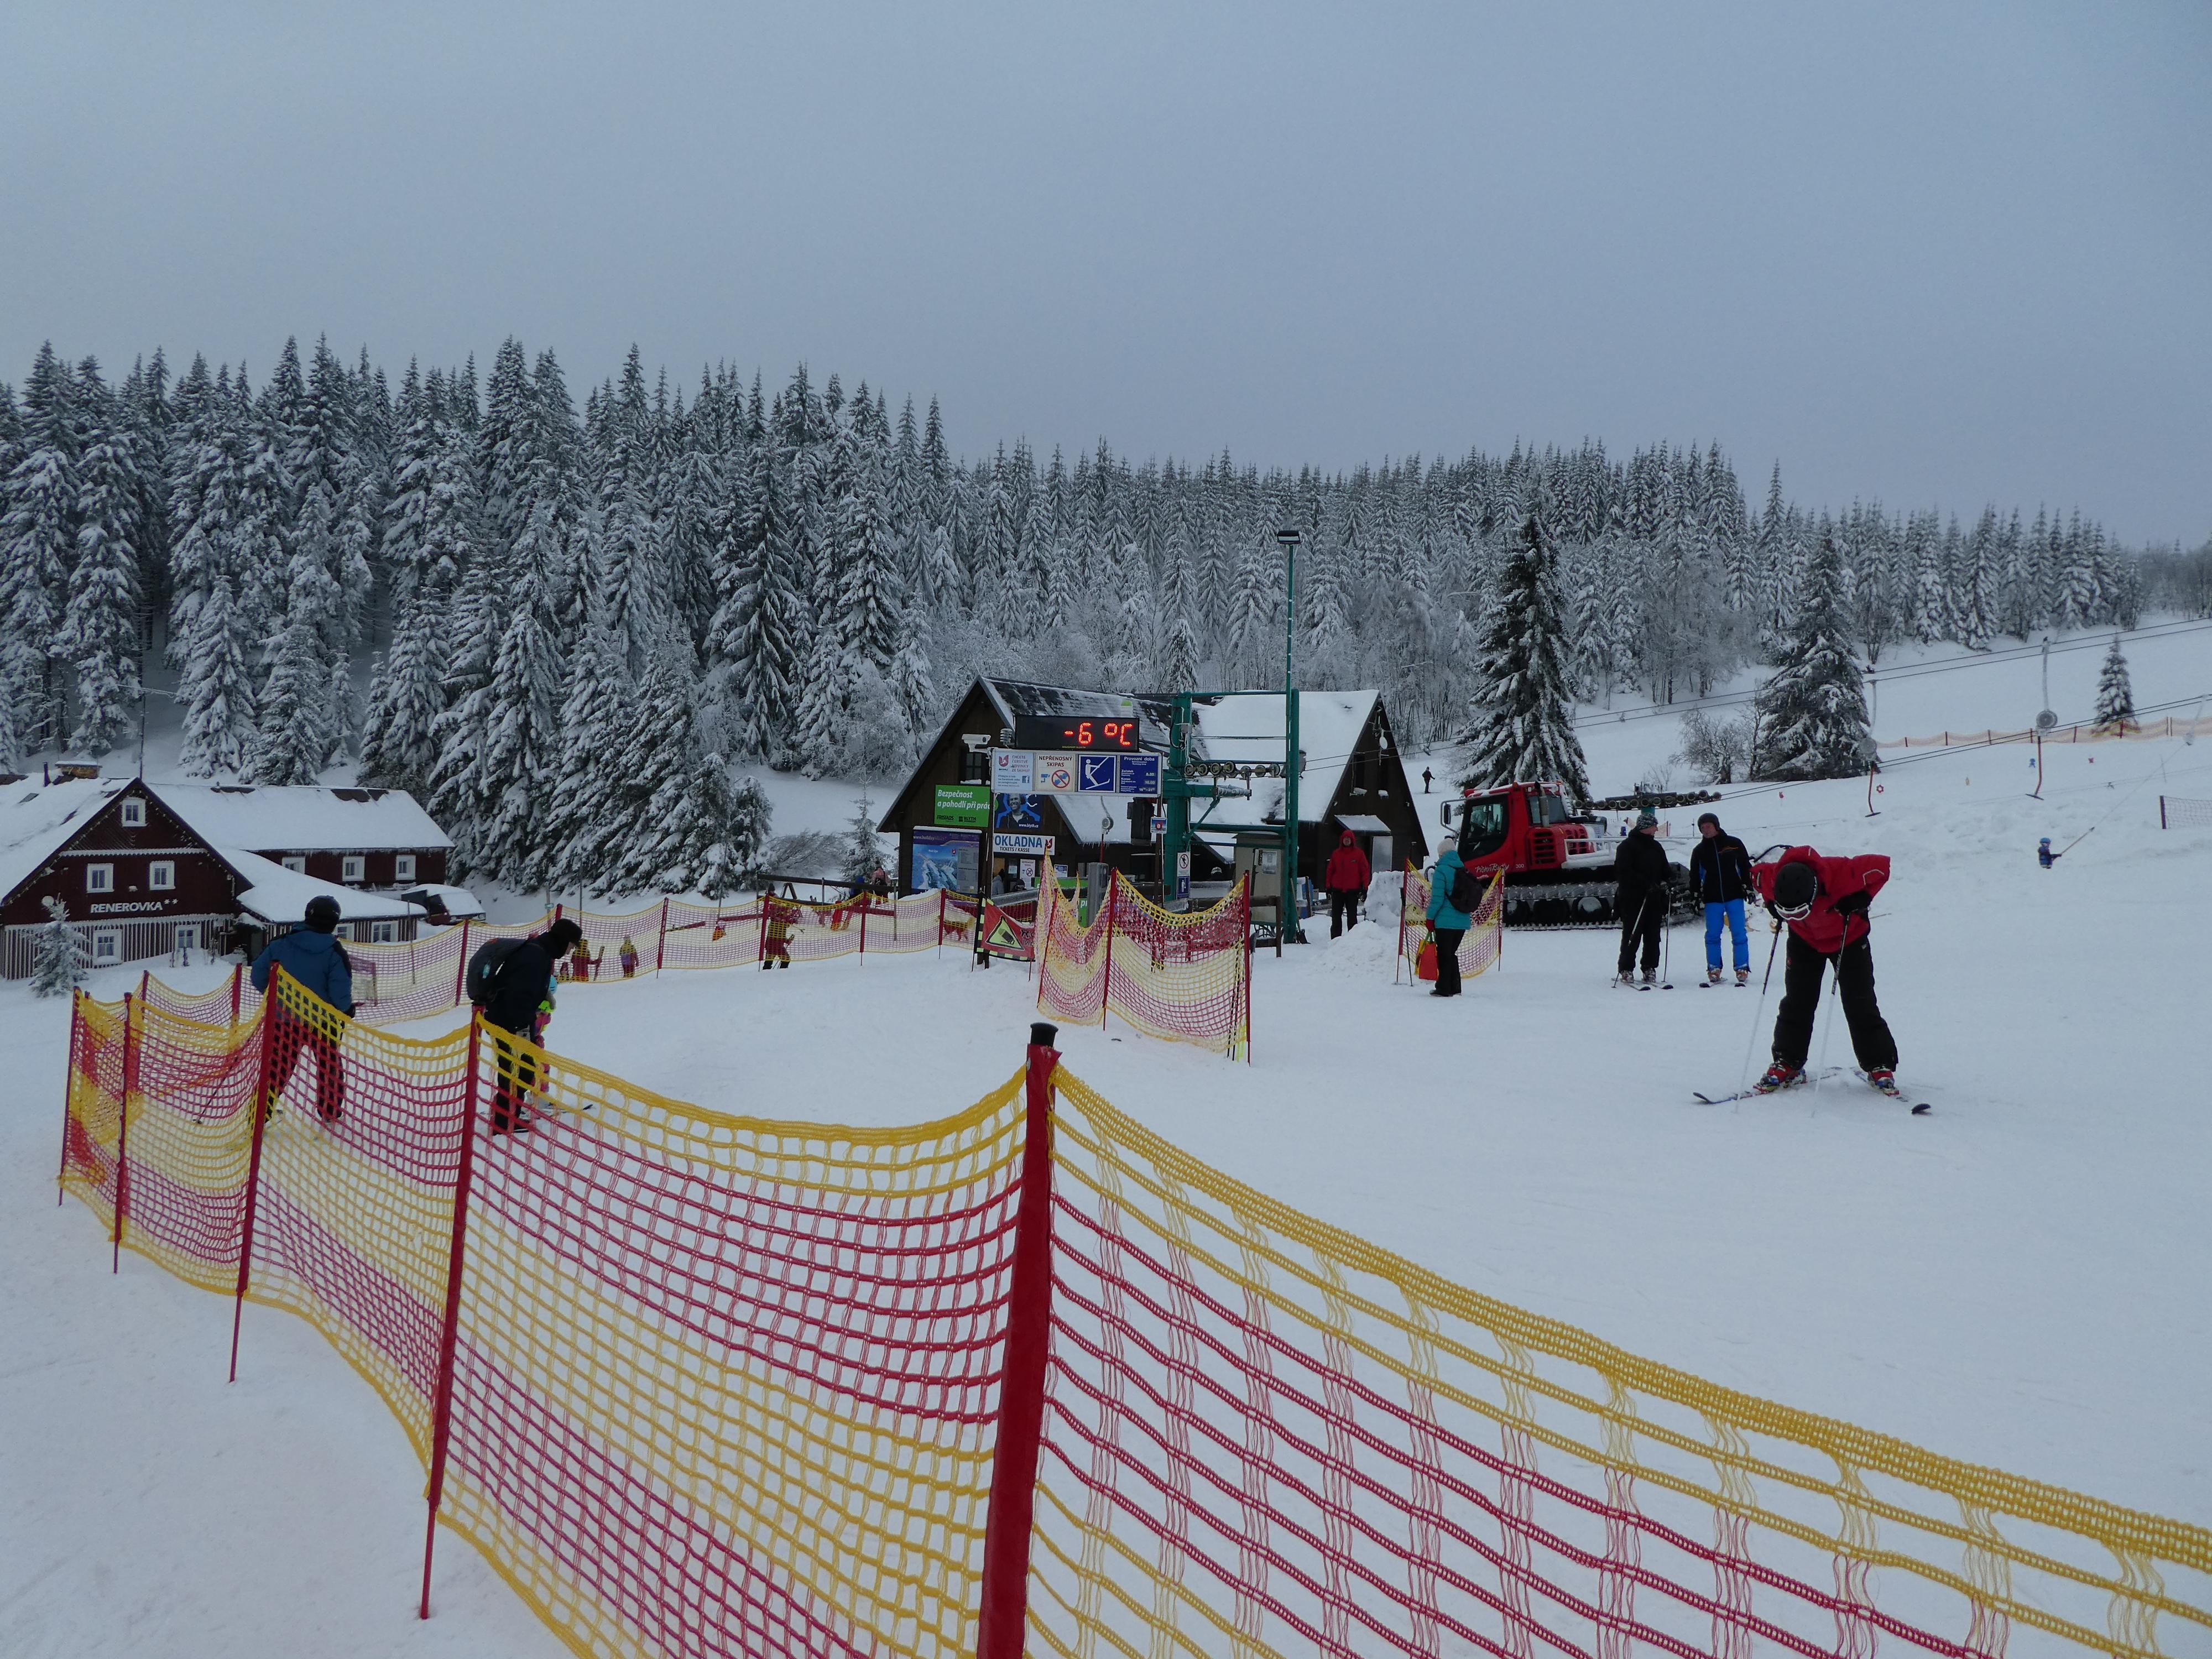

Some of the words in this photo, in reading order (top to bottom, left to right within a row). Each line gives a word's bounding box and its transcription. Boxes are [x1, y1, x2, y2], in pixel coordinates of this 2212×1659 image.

[1064, 722, 1092, 744] -6
[938, 790, 973, 799] Bezpečnost
[942, 800, 966, 809] pohodlí
[967, 801, 976, 810] při
[977, 802, 990, 811] prác
[994, 835, 1042, 848] OKLADNA
[90, 901, 163, 913] RENEROVKA
